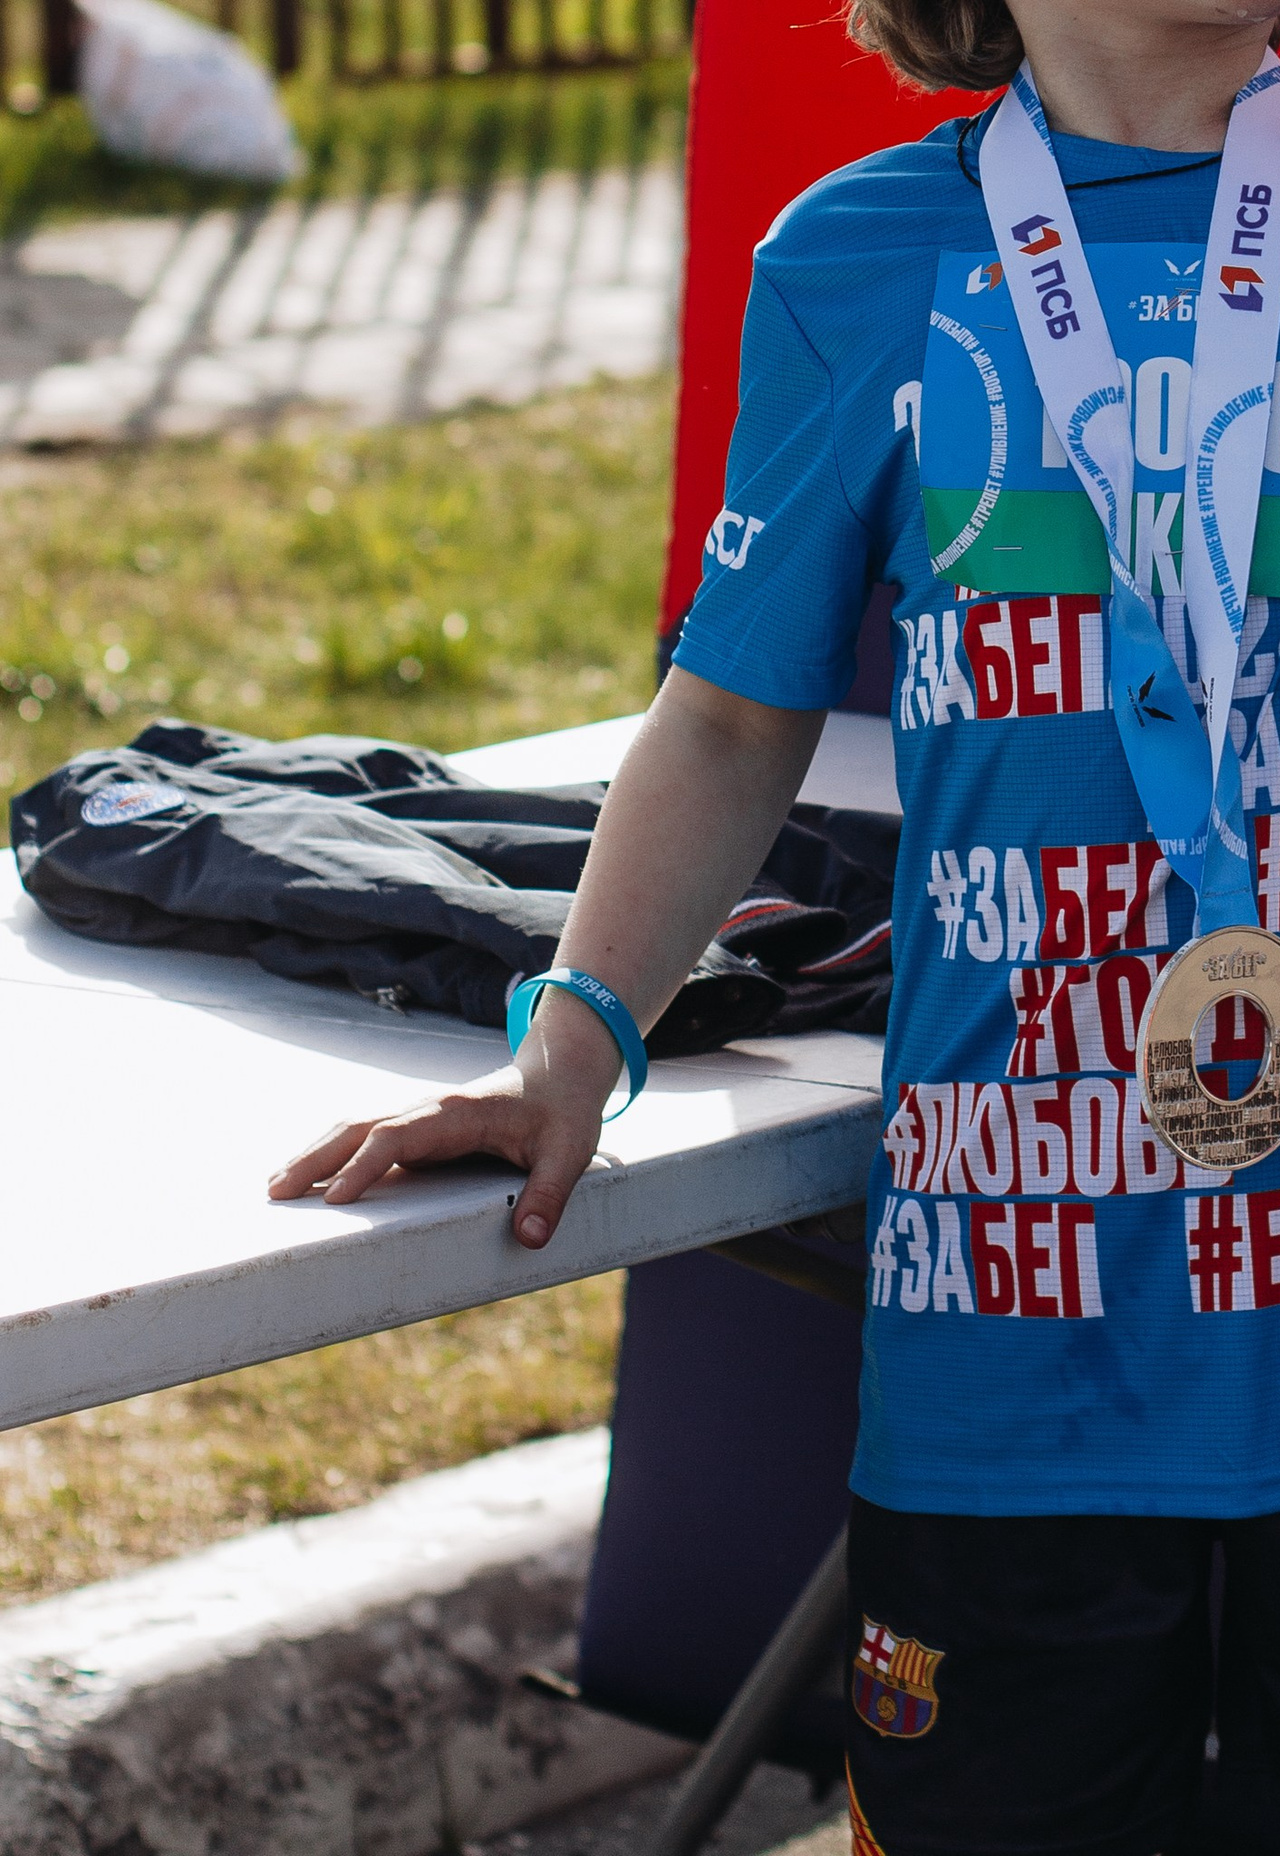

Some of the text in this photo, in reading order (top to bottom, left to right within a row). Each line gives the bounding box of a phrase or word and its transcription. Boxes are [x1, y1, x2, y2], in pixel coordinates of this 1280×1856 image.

[1231, 183, 1272, 258] ПСБ
[929, 309, 980, 351] #АДРЕНАЛ
[1030, 259, 1081, 341] ПСБ
[1128, 295, 1200, 321] #ЗАБ
[970, 347, 1005, 402] #ВОСТОРГ
[988, 402, 1008, 479] #УДИВЛЕНИЕ
[1199, 385, 1267, 454] #УДИВЛЕНИЕ
[1066, 385, 1125, 543] #САМОВЫРАЖЕНИЕ #ГОРДОСТ
[1196, 455, 1215, 512] #ТРЕПЕТ
[969, 478, 1002, 529] #ТРЕПЕТ
[1200, 512, 1232, 586] #ВОЛНЕНИЕ
[1156, 1054, 1192, 1072] #ГОРДОС
[872, 1195, 1104, 1317] #ЗАБЕГ
